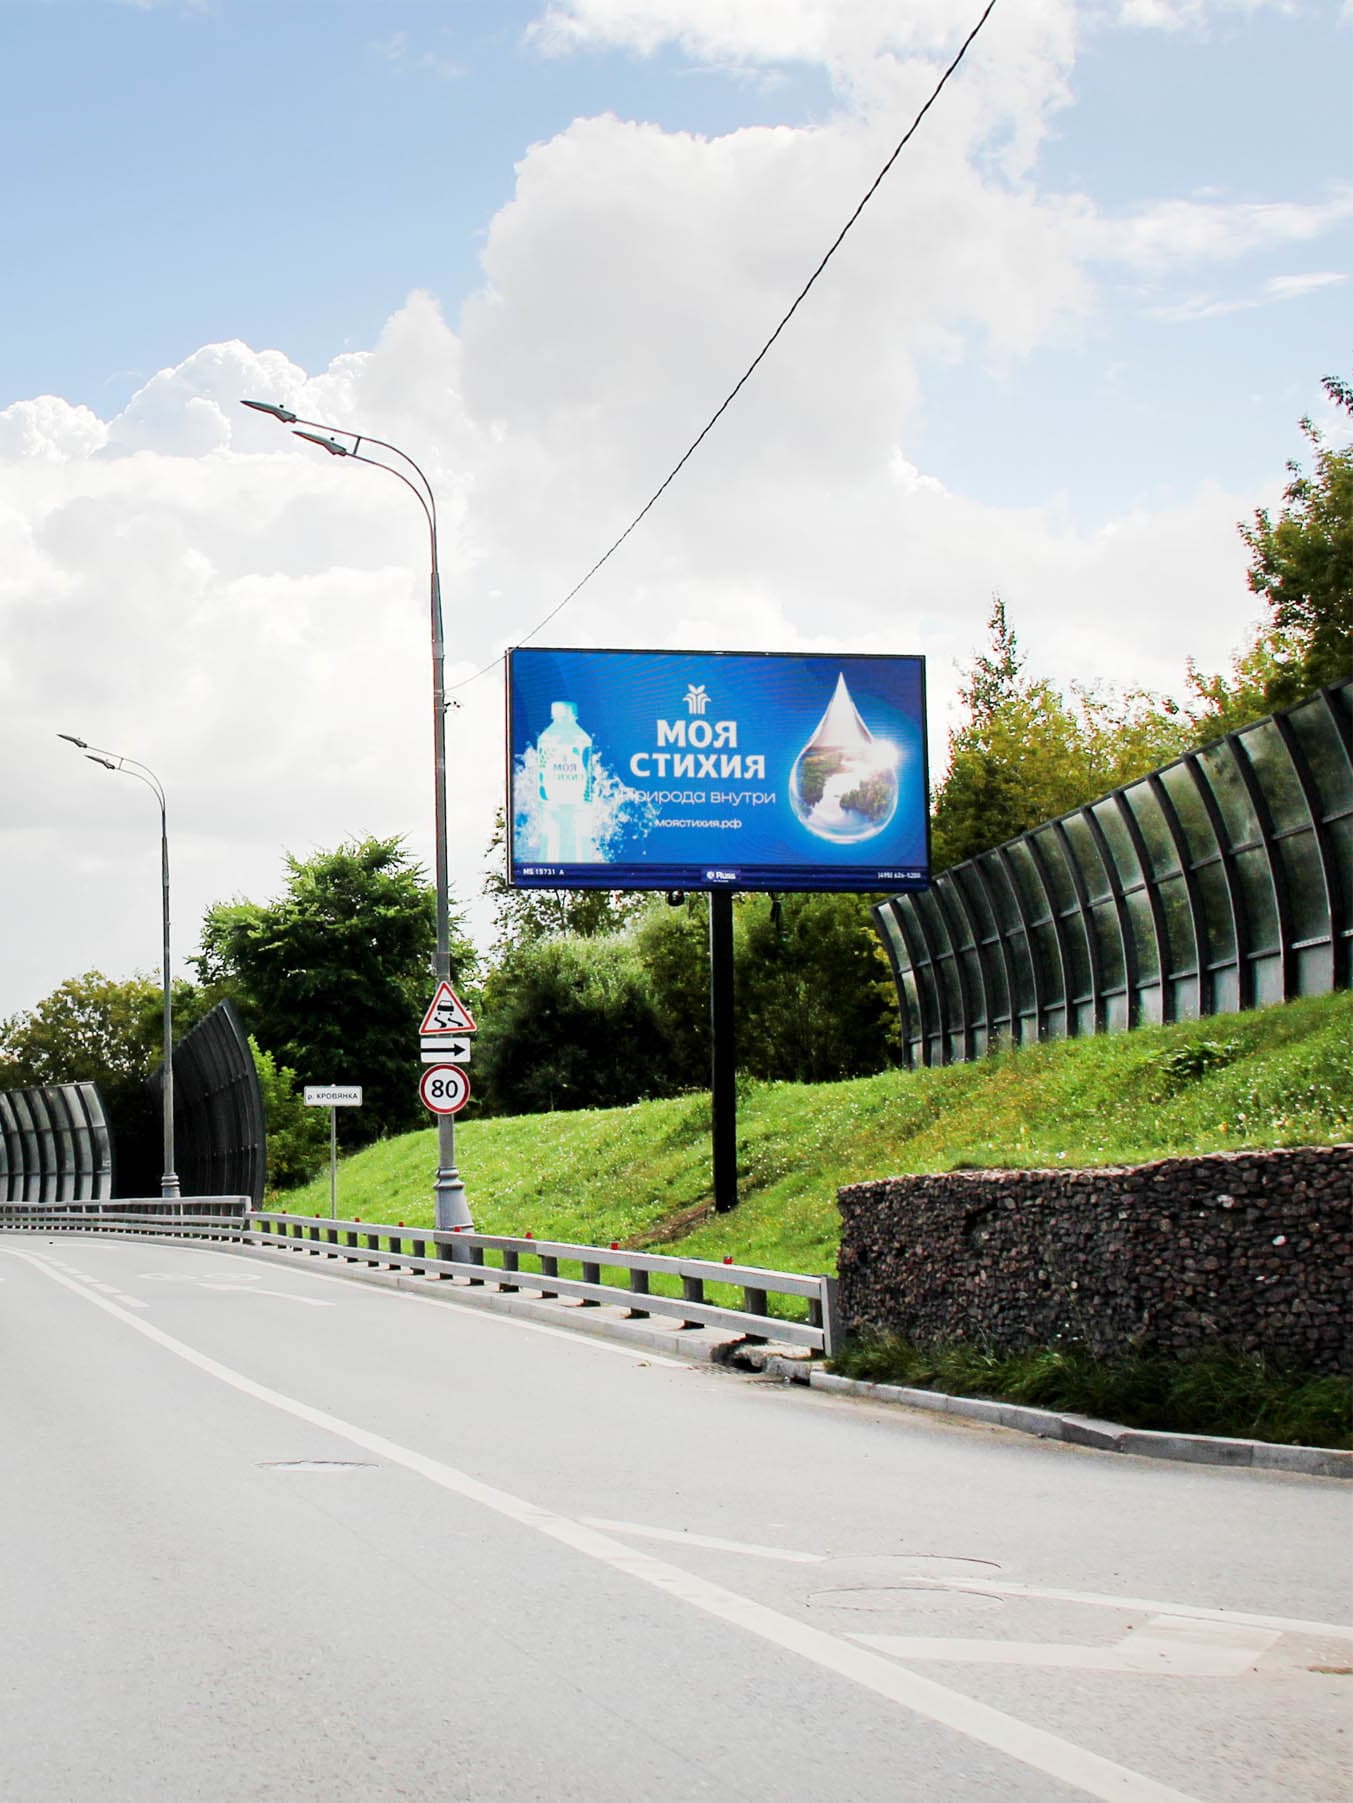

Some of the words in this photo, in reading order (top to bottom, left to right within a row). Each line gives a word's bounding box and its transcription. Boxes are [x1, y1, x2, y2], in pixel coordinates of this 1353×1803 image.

[656, 719, 738, 748] МОЯ
[629, 753, 766, 779] СТИХИЯ
[622, 789, 706, 805] рирода
[710, 791, 777, 806] внутри
[654, 818, 743, 830] моястихия.рф
[431, 1079, 458, 1099] 80
